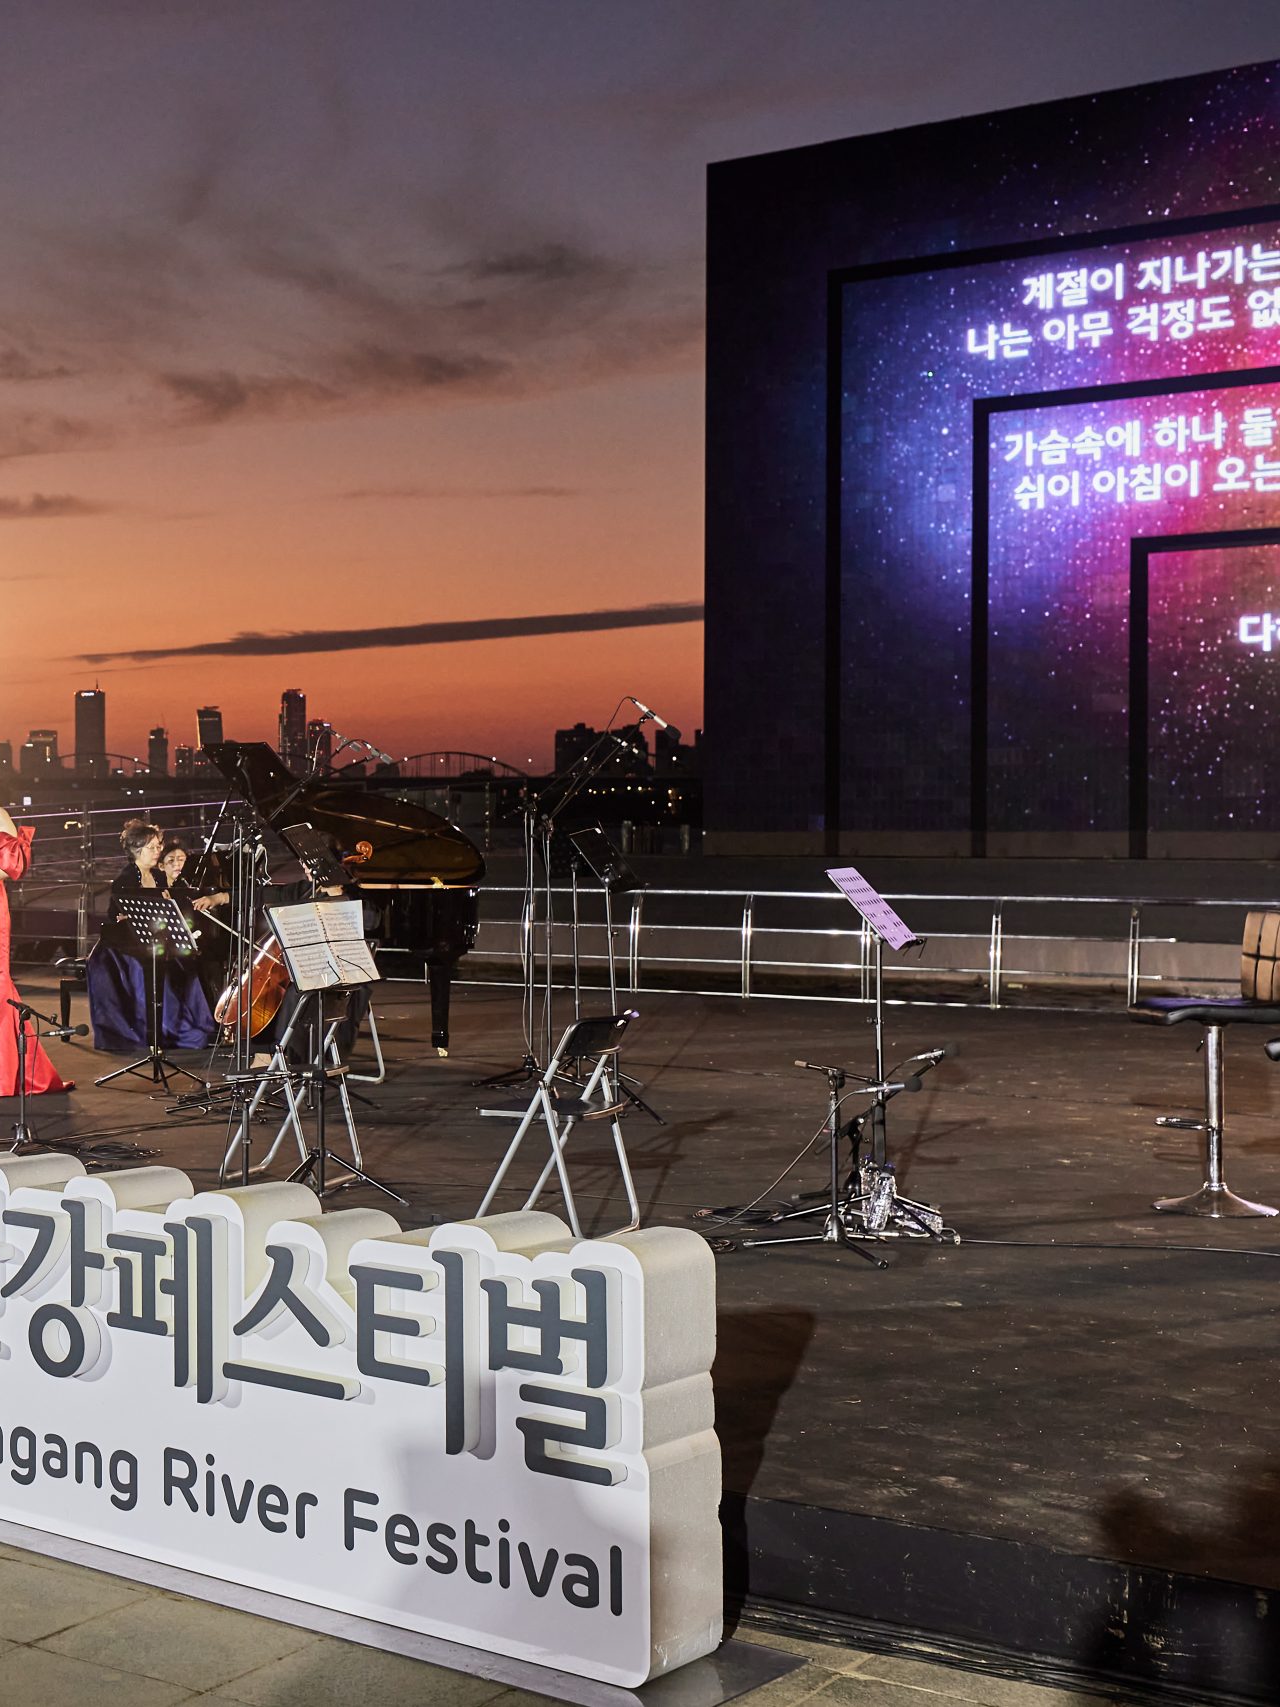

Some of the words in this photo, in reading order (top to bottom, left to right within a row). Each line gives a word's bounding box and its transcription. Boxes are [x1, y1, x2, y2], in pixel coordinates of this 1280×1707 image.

[1022, 263, 1124, 309] 계절이
[1136, 243, 1280, 294] 지나가는
[967, 322, 1033, 360] 나는
[1043, 311, 1113, 350] 아무
[1126, 295, 1235, 341] 걱정도
[1004, 419, 1141, 467] 가슴속에
[1153, 411, 1228, 453] 하나
[1238, 407, 1278, 447] 둘
[1013, 470, 1080, 510] 쉬이
[1091, 459, 1199, 503] 아침이
[1212, 454, 1280, 492] 오는
[1239, 612, 1280, 652] 다
[162, 1445, 319, 1541] River
[342, 1486, 624, 1618] Festival
